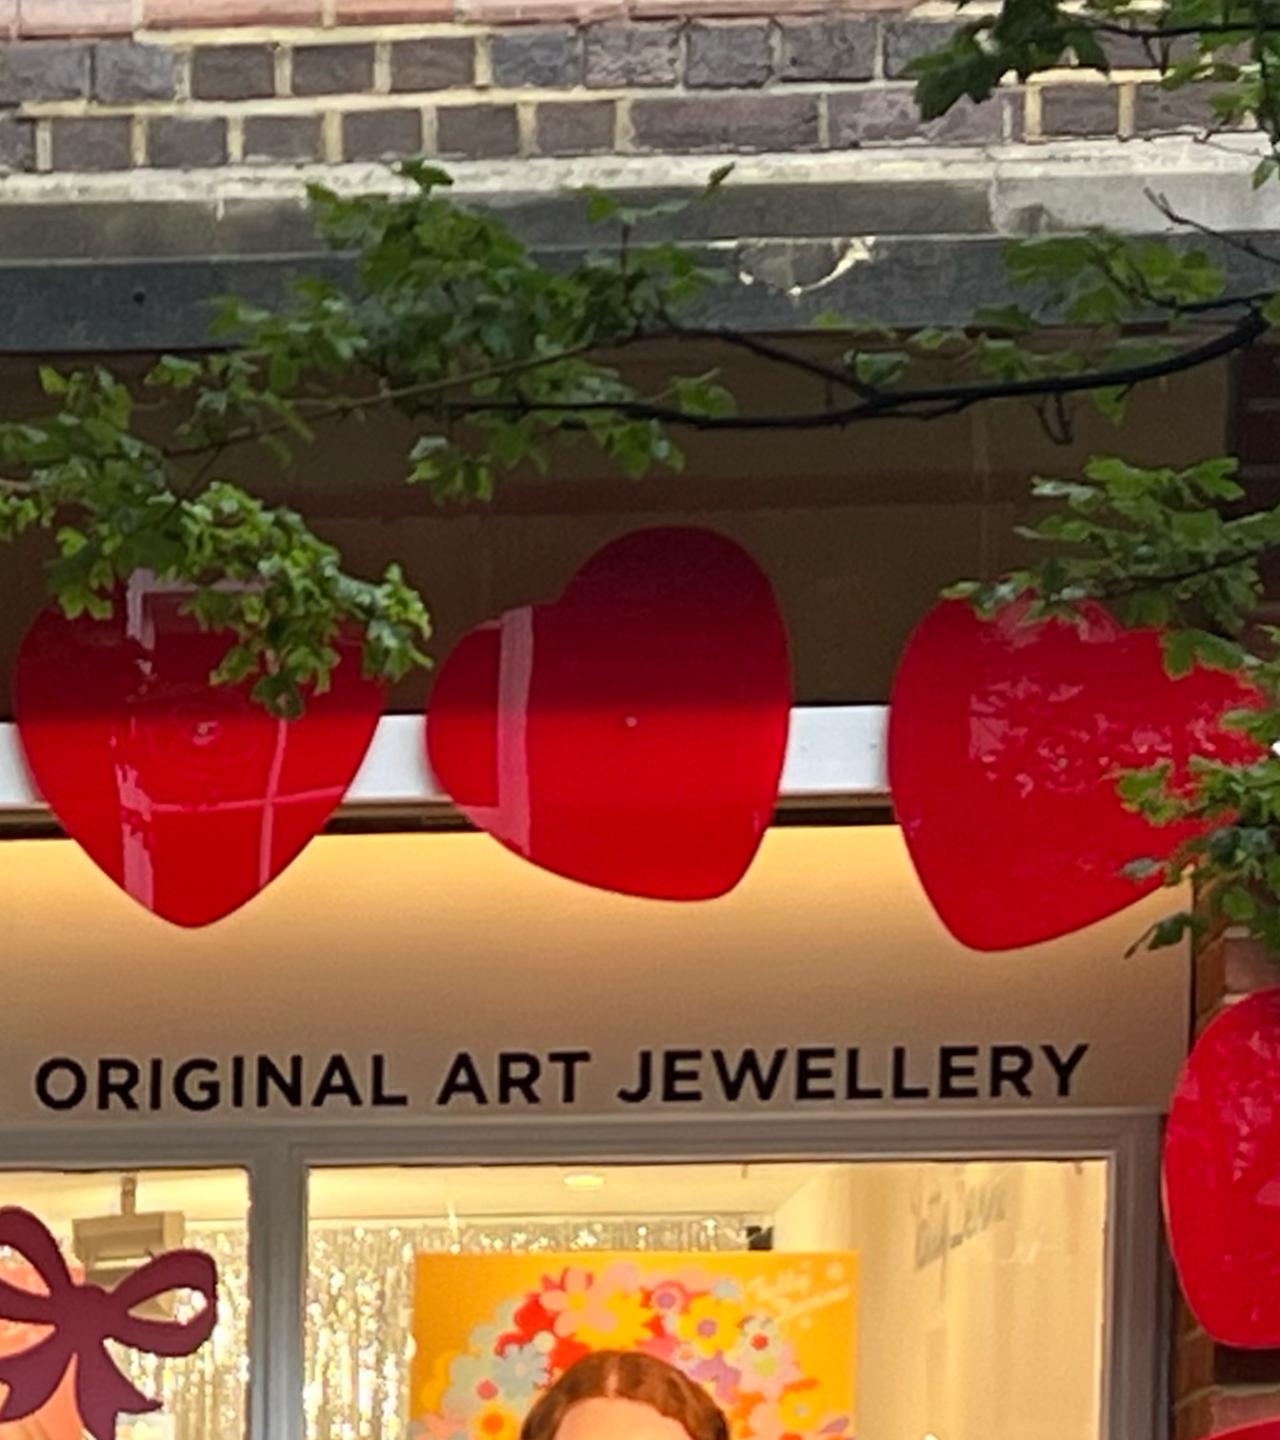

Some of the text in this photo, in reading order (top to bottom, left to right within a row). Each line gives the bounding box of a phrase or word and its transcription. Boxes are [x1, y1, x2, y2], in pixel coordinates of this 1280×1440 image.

[34, 1042, 1091, 1112] ORIGINAL ART JEWELLERY
